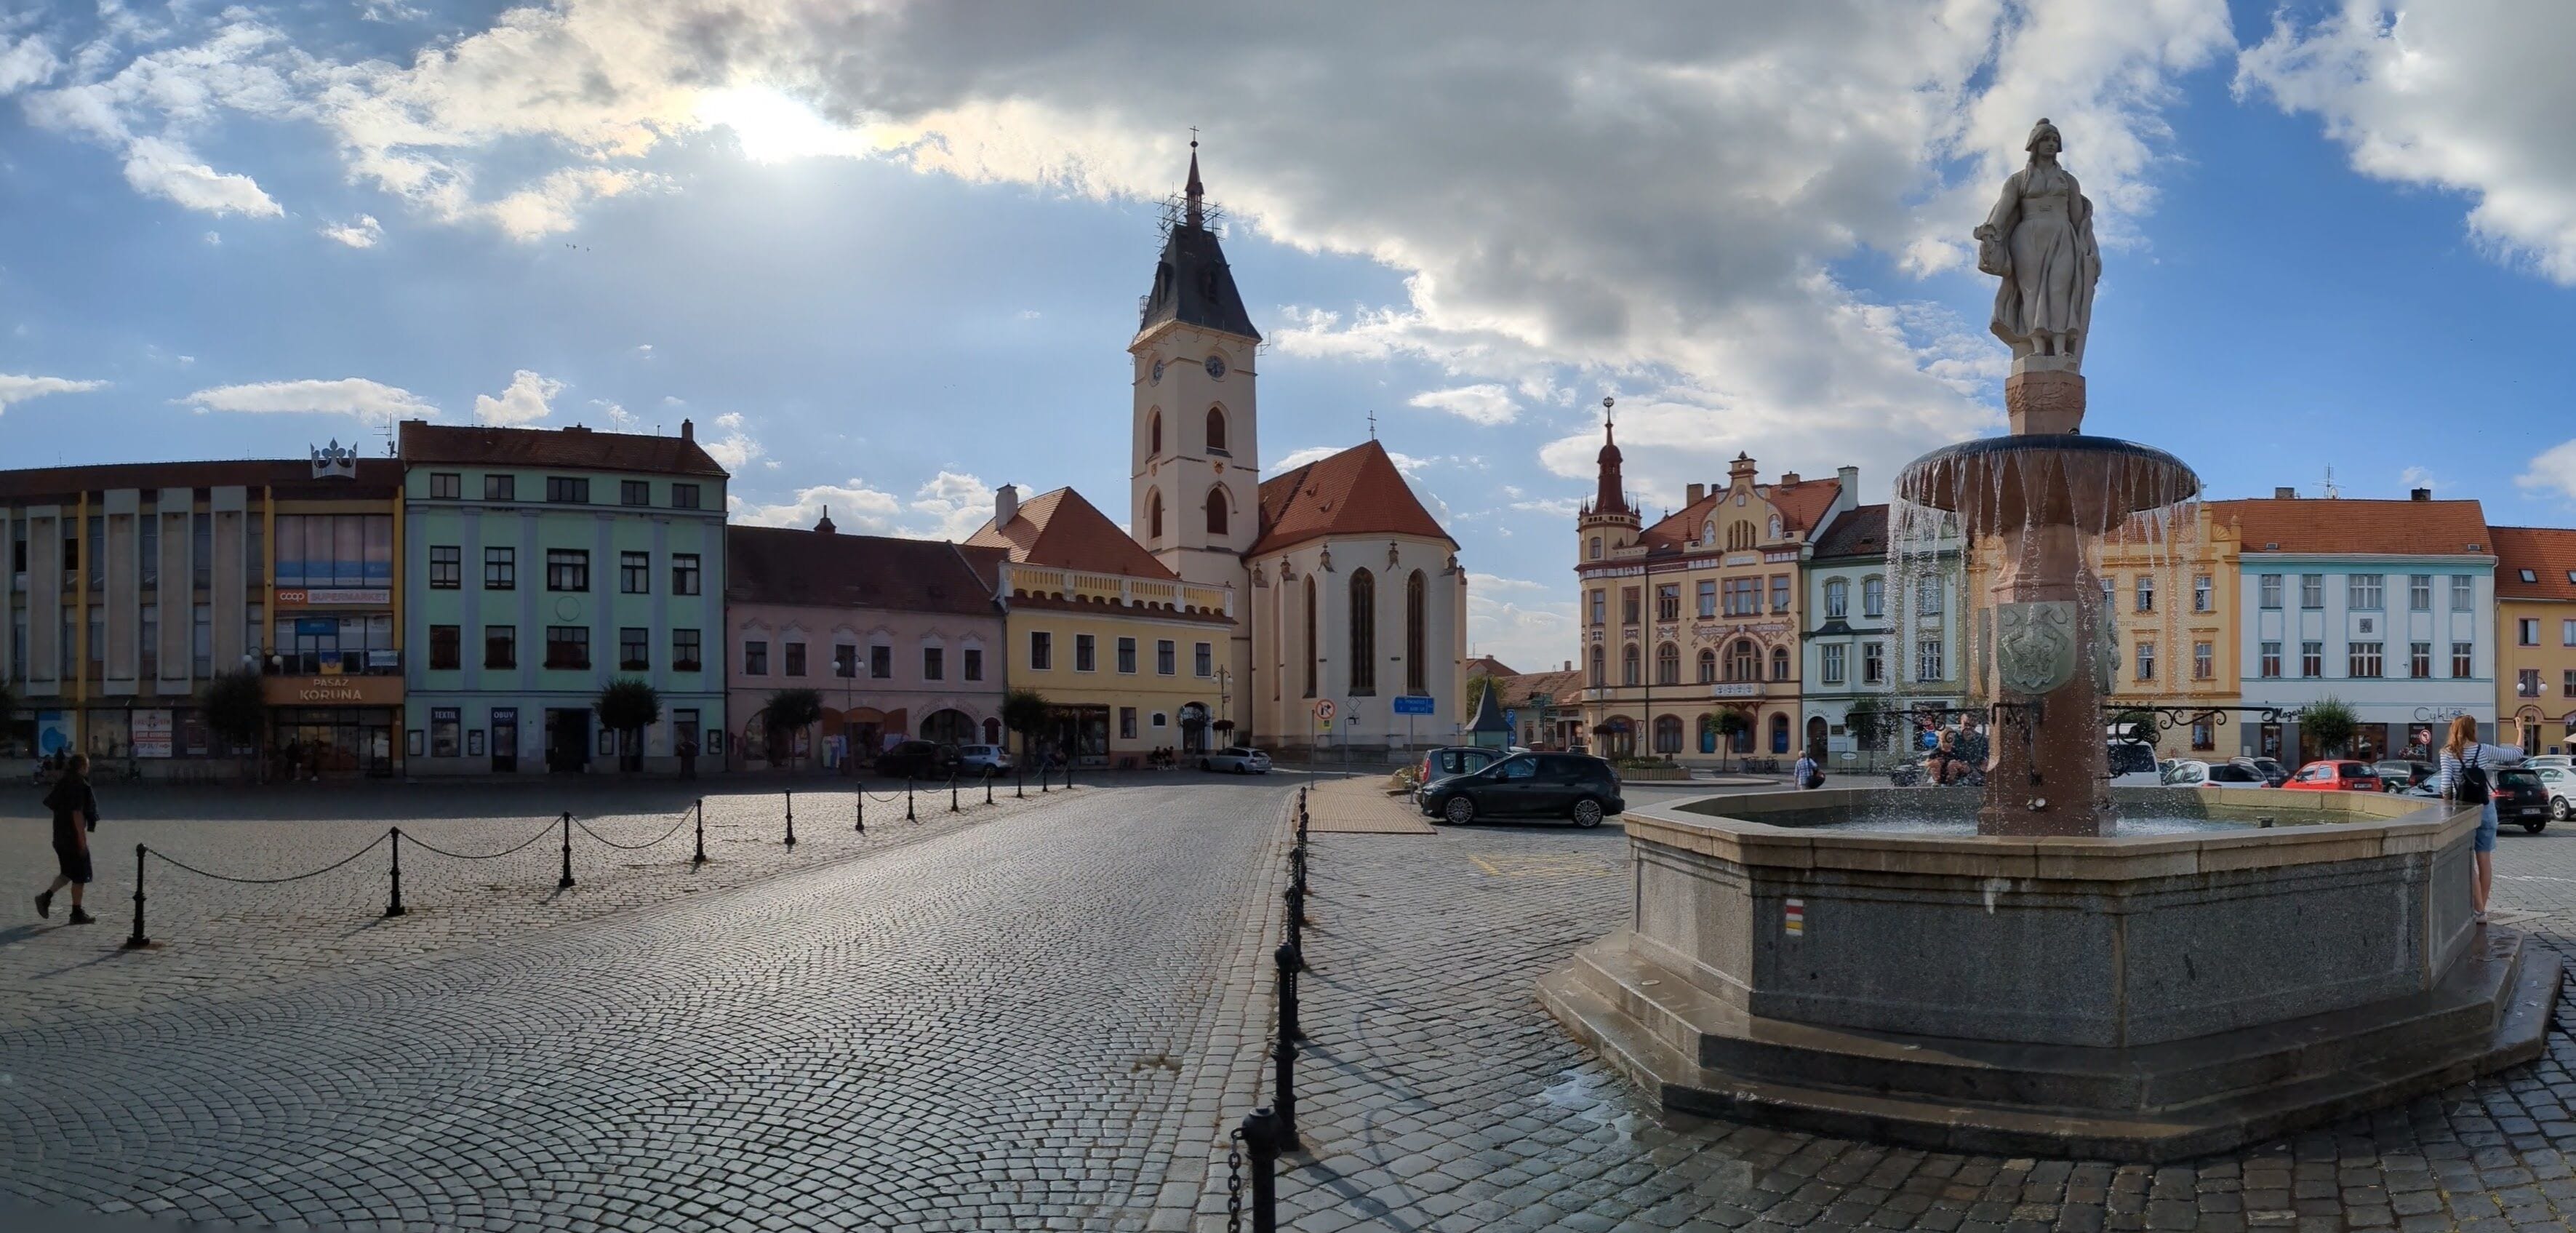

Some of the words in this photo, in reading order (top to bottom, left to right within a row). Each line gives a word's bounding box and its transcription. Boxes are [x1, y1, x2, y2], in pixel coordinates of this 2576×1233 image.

[311, 593, 386, 602] SUPERMARKET
[300, 690, 362, 701] KORUNA
[1508, 711, 1513, 722] P
[2262, 706, 2305, 722] Mozart
